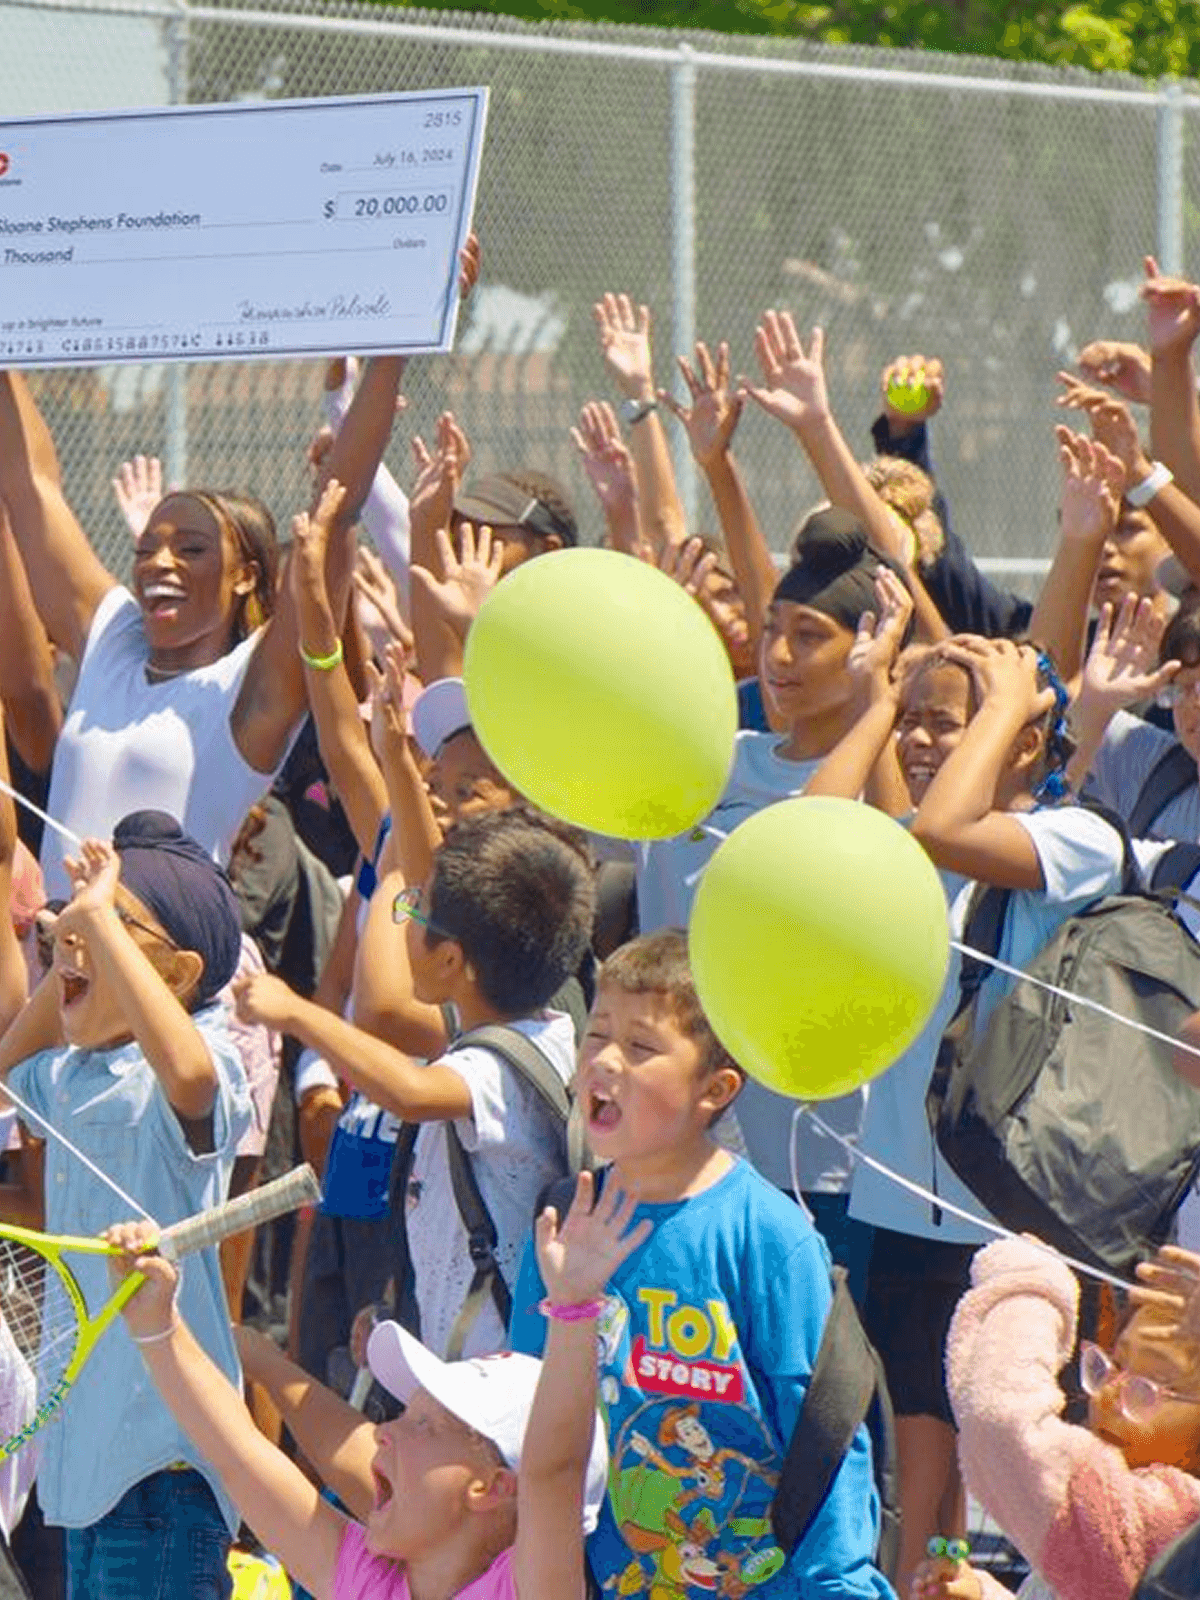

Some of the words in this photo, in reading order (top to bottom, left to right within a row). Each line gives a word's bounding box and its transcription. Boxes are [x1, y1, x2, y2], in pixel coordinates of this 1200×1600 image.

[373, 151, 396, 168] July
[422, 148, 453, 163] 2024
[323, 200, 335, 219] $
[355, 194, 448, 219] 20,000.00
[48, 216, 113, 235] Stephens
[117, 210, 200, 229] Foundation
[5, 246, 74, 264] Thousand
[637, 1287, 738, 1360] TOY
[638, 1355, 736, 1395] STORY
